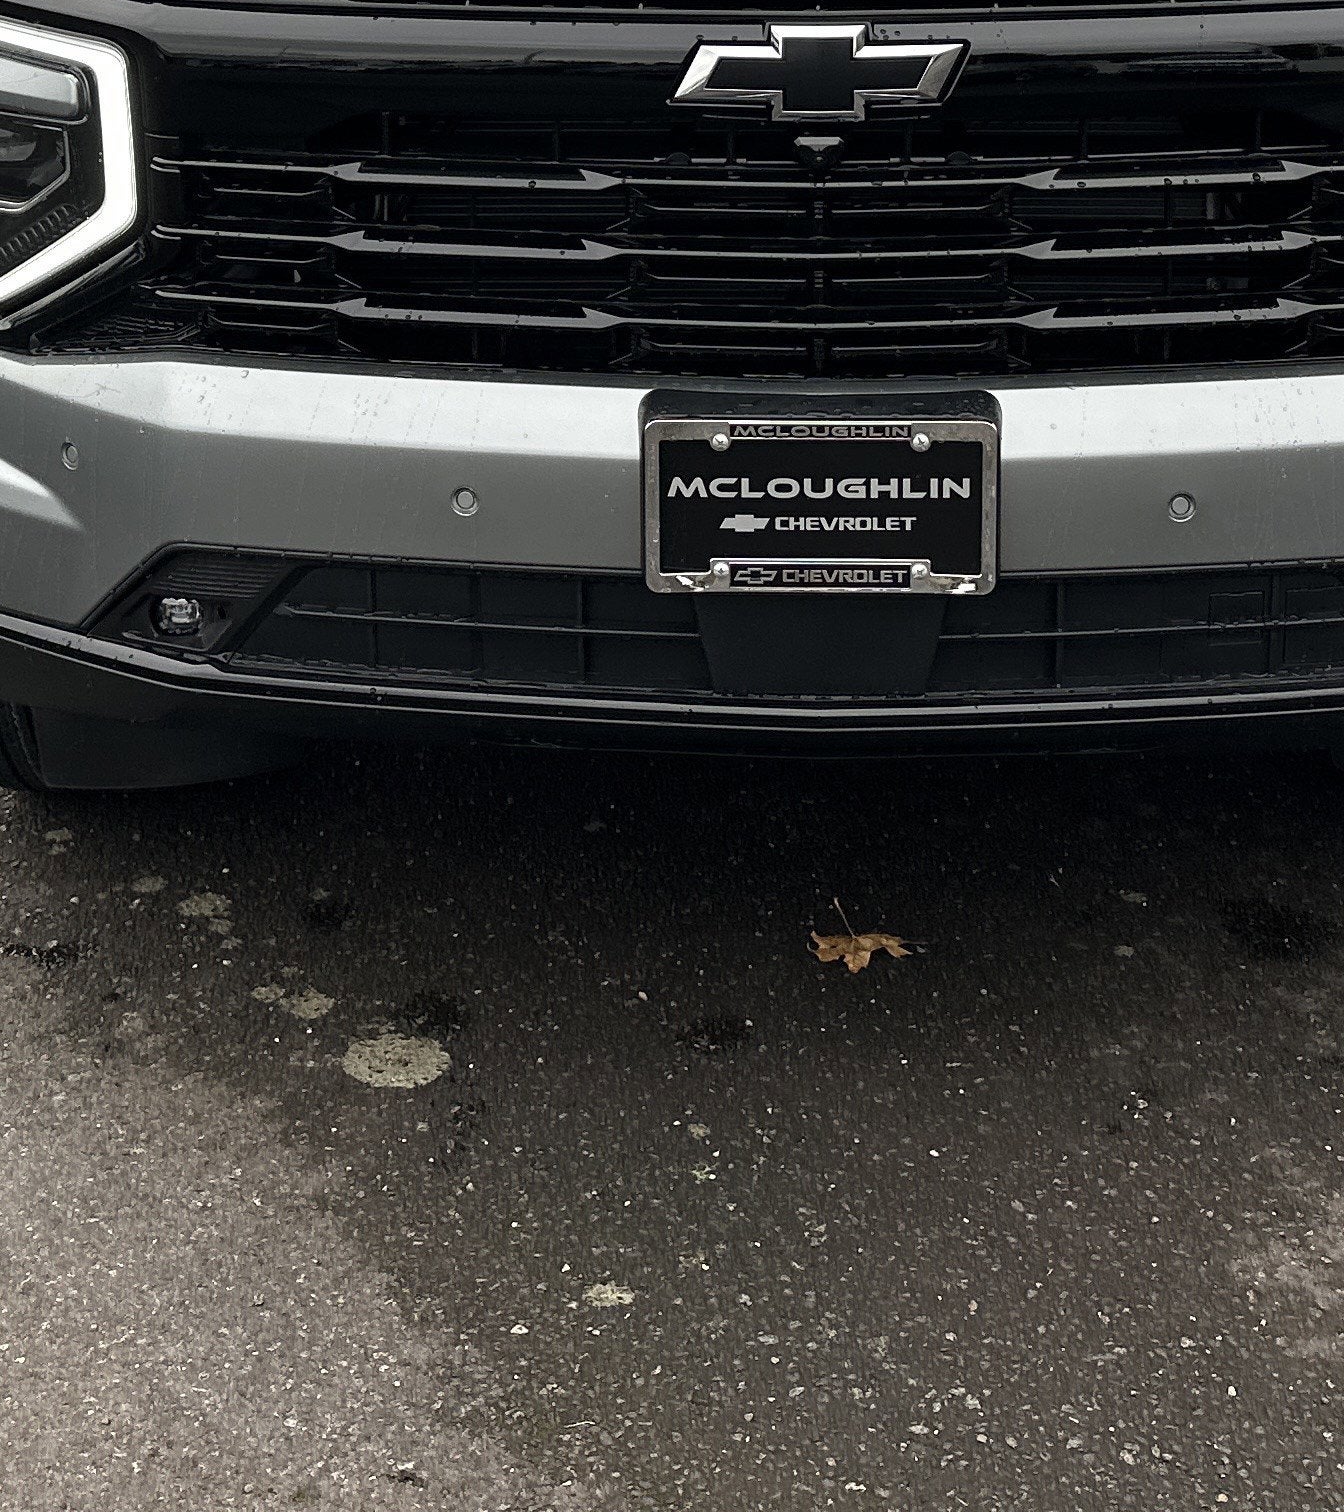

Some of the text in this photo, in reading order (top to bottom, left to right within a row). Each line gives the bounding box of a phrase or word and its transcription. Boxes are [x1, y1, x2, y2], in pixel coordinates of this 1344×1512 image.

[734, 425, 911, 438] MCLOUGHLIN
[667, 477, 971, 500] MCLOUGHLIN
[774, 516, 917, 532] CHEVROLET
[782, 568, 908, 584] CHEVROLET
